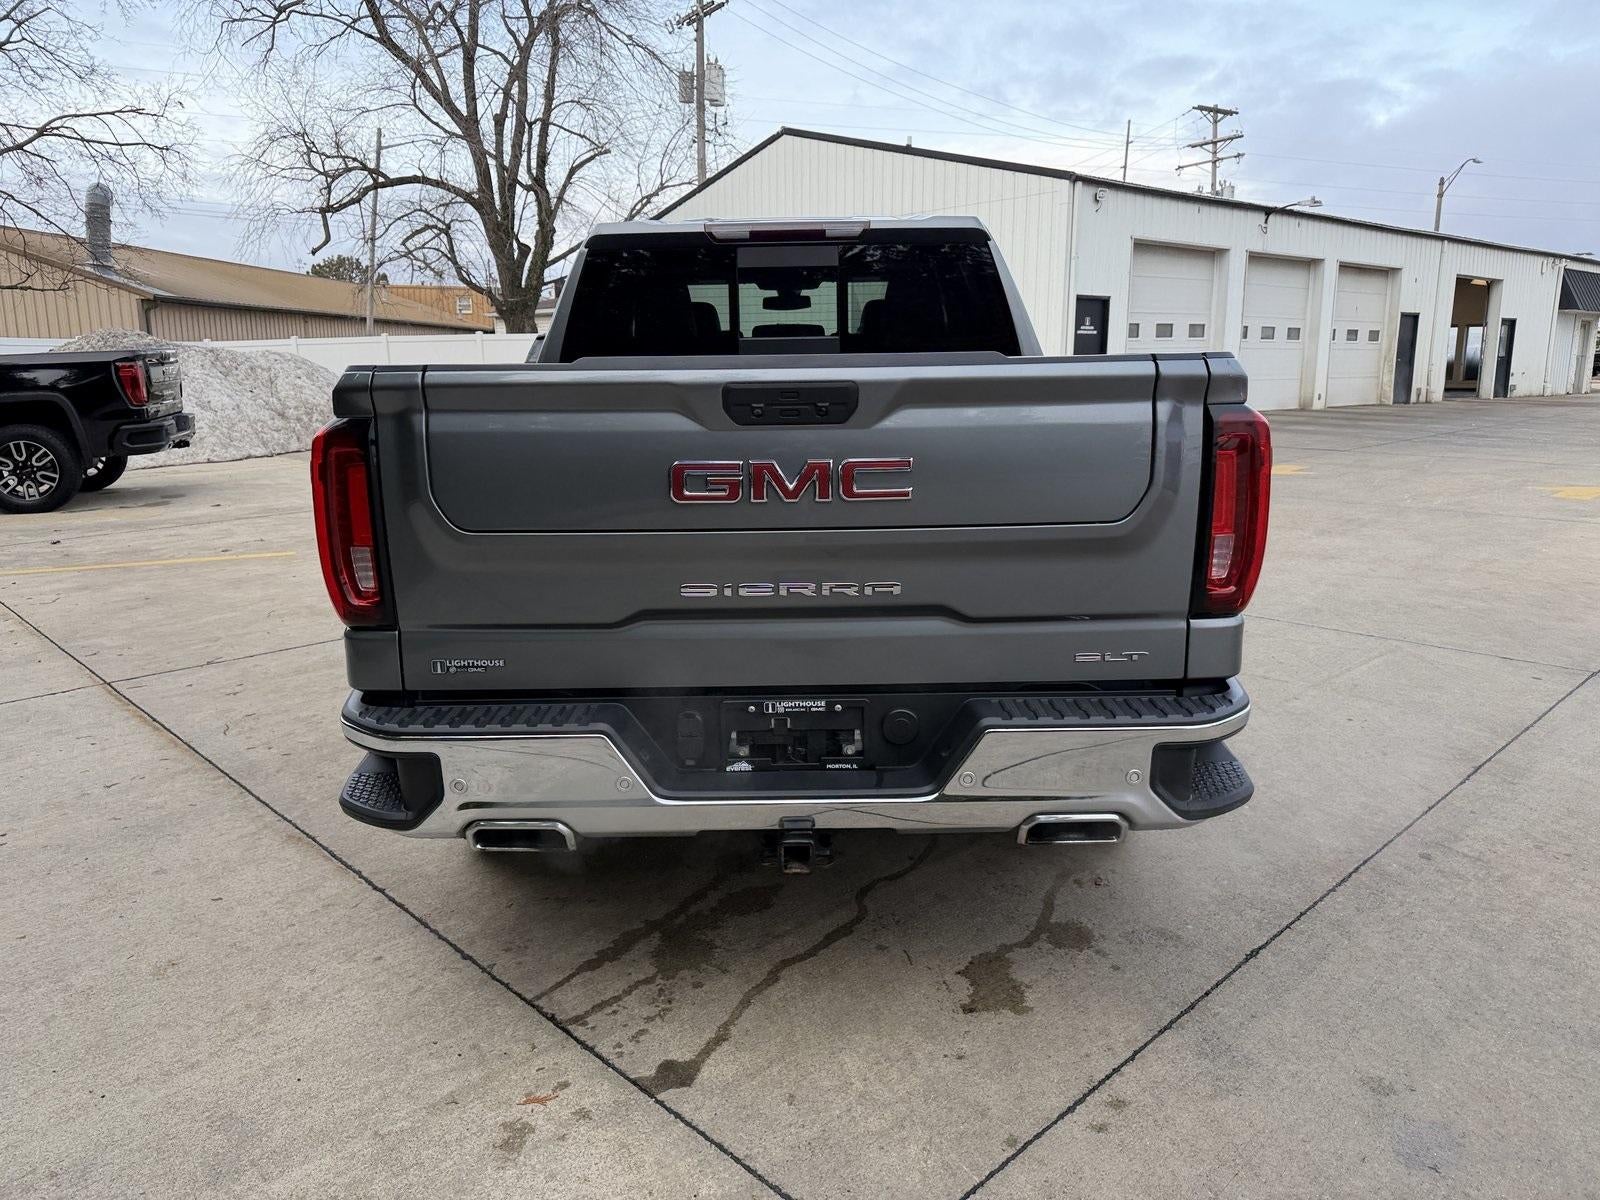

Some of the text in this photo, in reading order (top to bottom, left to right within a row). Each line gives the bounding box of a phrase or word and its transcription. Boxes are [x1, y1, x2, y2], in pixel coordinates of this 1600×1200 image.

[670, 457, 914, 504] GMC
[680, 582, 902, 597] SIERRA
[1075, 651, 1149, 662] SLT
